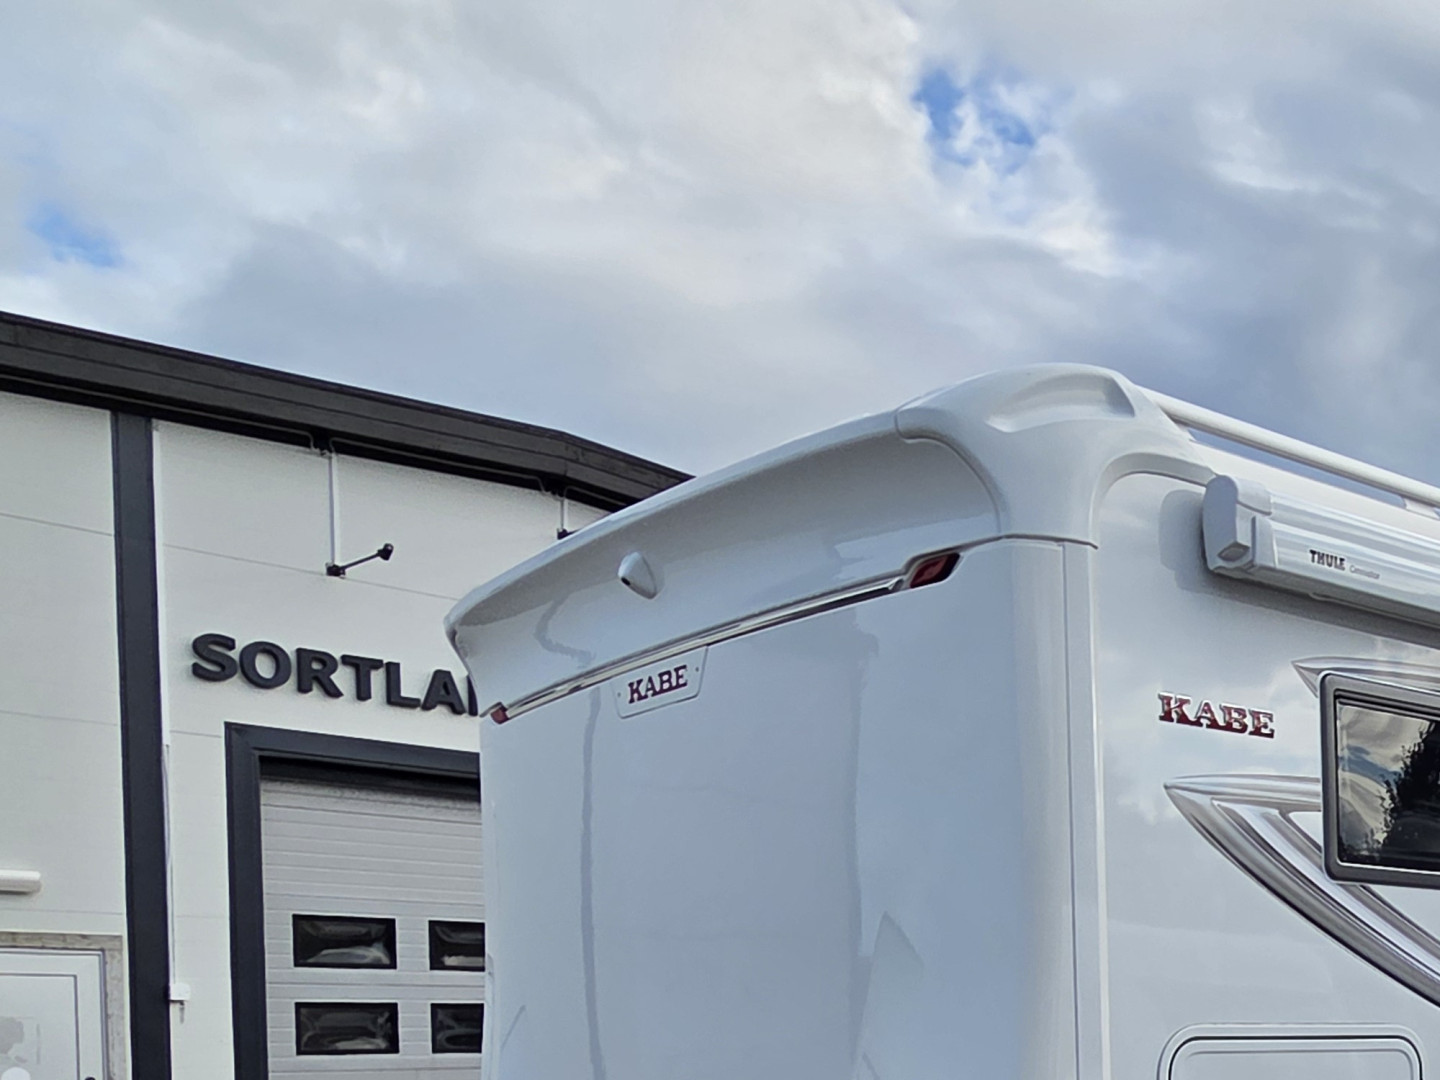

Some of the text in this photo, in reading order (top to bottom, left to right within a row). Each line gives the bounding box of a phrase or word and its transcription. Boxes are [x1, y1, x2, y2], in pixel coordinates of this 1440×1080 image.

[1309, 549, 1346, 571] THULE
[191, 633, 478, 717] SORTLA
[628, 664, 688, 704] KABE
[1158, 692, 1275, 739] KABE
